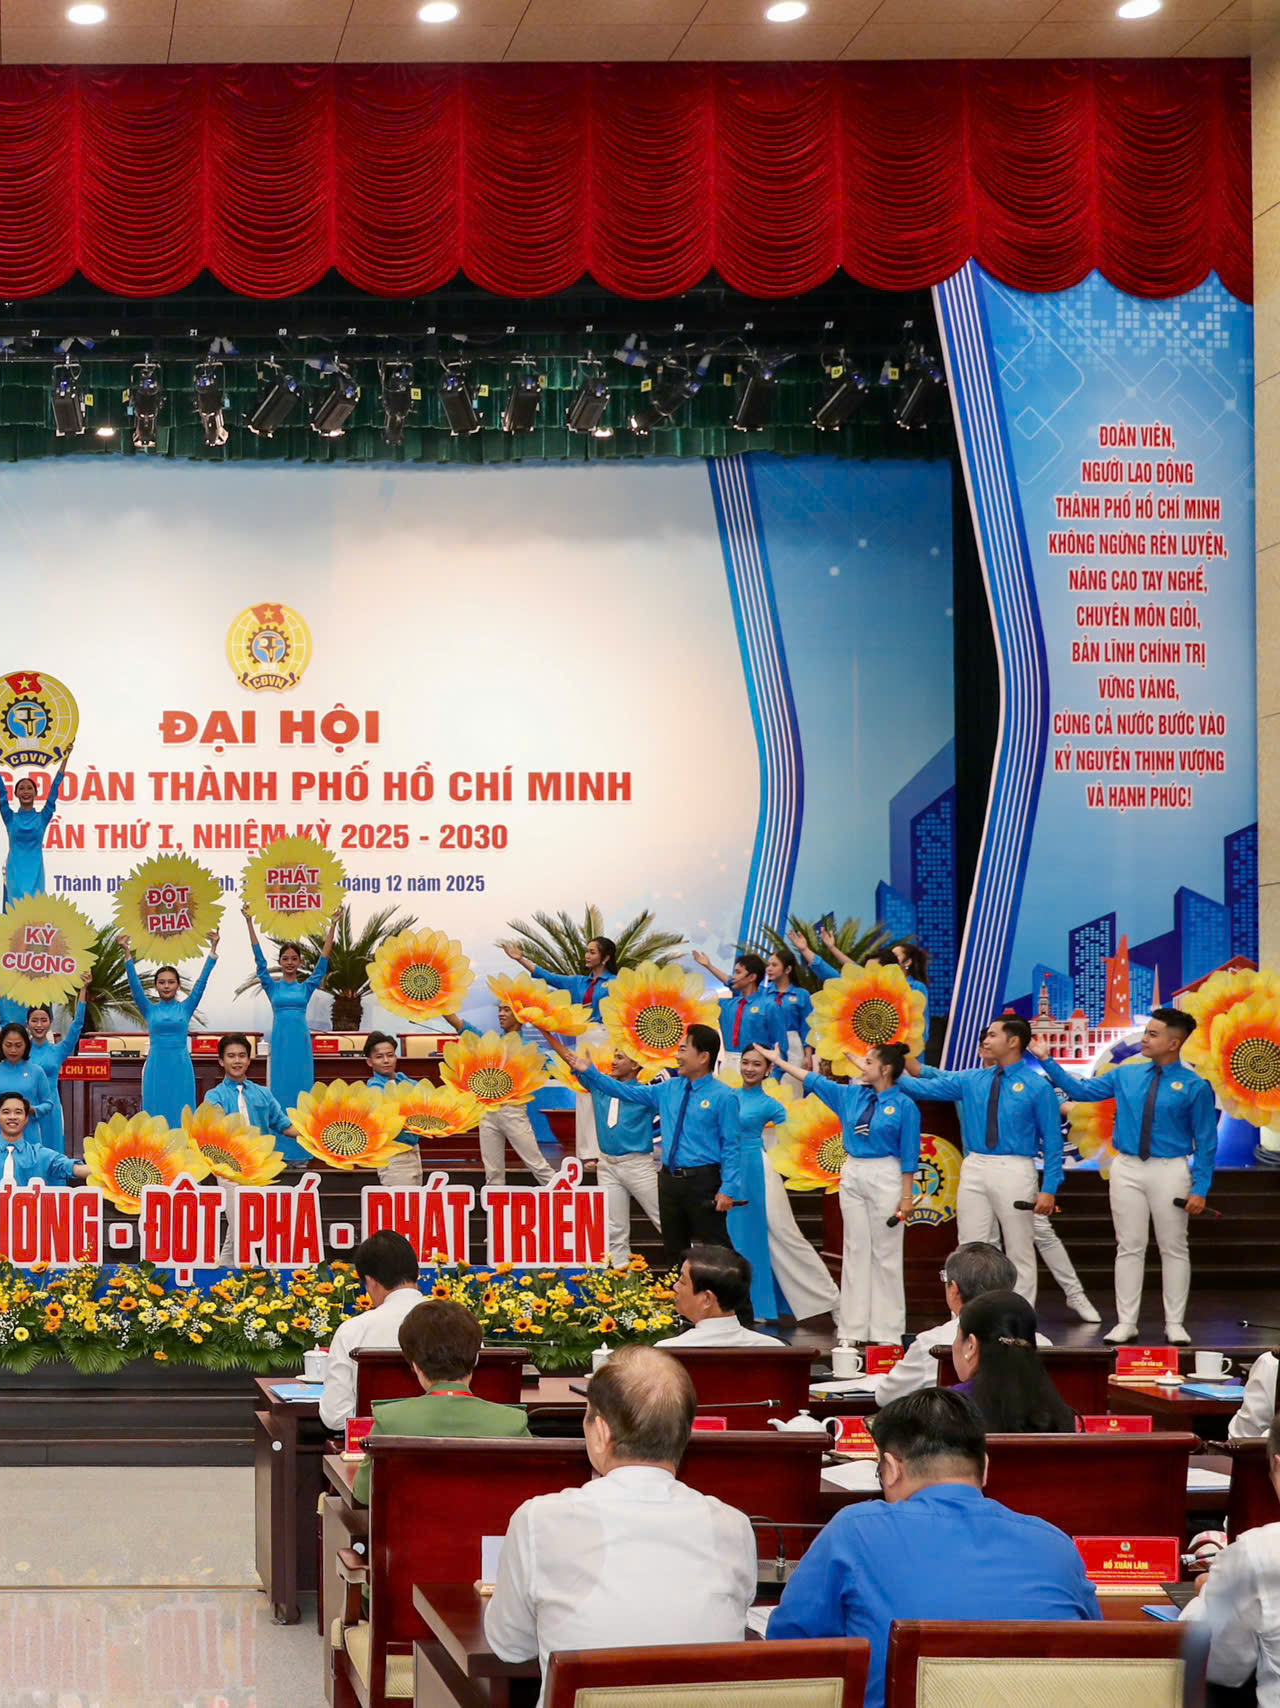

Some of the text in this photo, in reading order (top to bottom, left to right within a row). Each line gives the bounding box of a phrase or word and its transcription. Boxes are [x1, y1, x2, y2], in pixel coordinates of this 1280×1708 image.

[1099, 423, 1177, 449] ĐOÀN VIÊN,
[1082, 459, 1195, 485] NGƯỜI LAO ĐỘNG
[1055, 493, 1222, 521] THÀNH PHỐ HỒ CHÍ MINH
[1048, 529, 1228, 561] KHÔNG NGỪNG RÈN LUYỆN,
[1069, 565, 1209, 593] NÂNG CAO TAY NGHỀ,
[1077, 602, 1201, 629] CHUYÊN MÔN GIỎI,
[1071, 639, 1207, 667] BẢN LĨNH CHÍNH TRỊ
[1099, 676, 1181, 701] VỮNG VÀNG,
[159, 703, 380, 754] ĐẠI HỘI
[1053, 711, 1226, 737] CÙNG CẢ NƯỚC BƯỚC VÀO
[1055, 743, 1225, 774] KỶ NGUYÊN THỊNH VƯỢNG
[148, 765, 278, 802] THÀNH
[292, 760, 369, 802] PHỐ
[383, 761, 435, 802] HỒ
[449, 765, 513, 802] CHÍ
[528, 771, 632, 802] MINH
[1087, 783, 1193, 811] VÀ HẠNH PHÚC!
[42, 815, 85, 850] ẦN
[95, 818, 152, 850] THỨ
[193, 818, 286, 855] NHIỆM
[341, 823, 410, 850] 2025
[439, 823, 508, 850] 2030
[54, 875, 102, 893] Thành
[386, 875, 403, 892] 12
[407, 875, 441, 892] năm
[446, 875, 486, 892] 2025
[266, 864, 320, 885] PHÁT
[147, 884, 189, 908] ĐỘT
[266, 887, 322, 909] TRIỂN
[148, 909, 191, 931] PHÁ
[25, 925, 56, 945] KỶ
[2, 952, 76, 974] CƯƠNG
[143, 1178, 224, 1281] ĐỘT
[239, 1178, 321, 1263] PHÁ
[367, 1177, 470, 1263] PHÁT
[487, 1163, 605, 1263] TRIỂN
